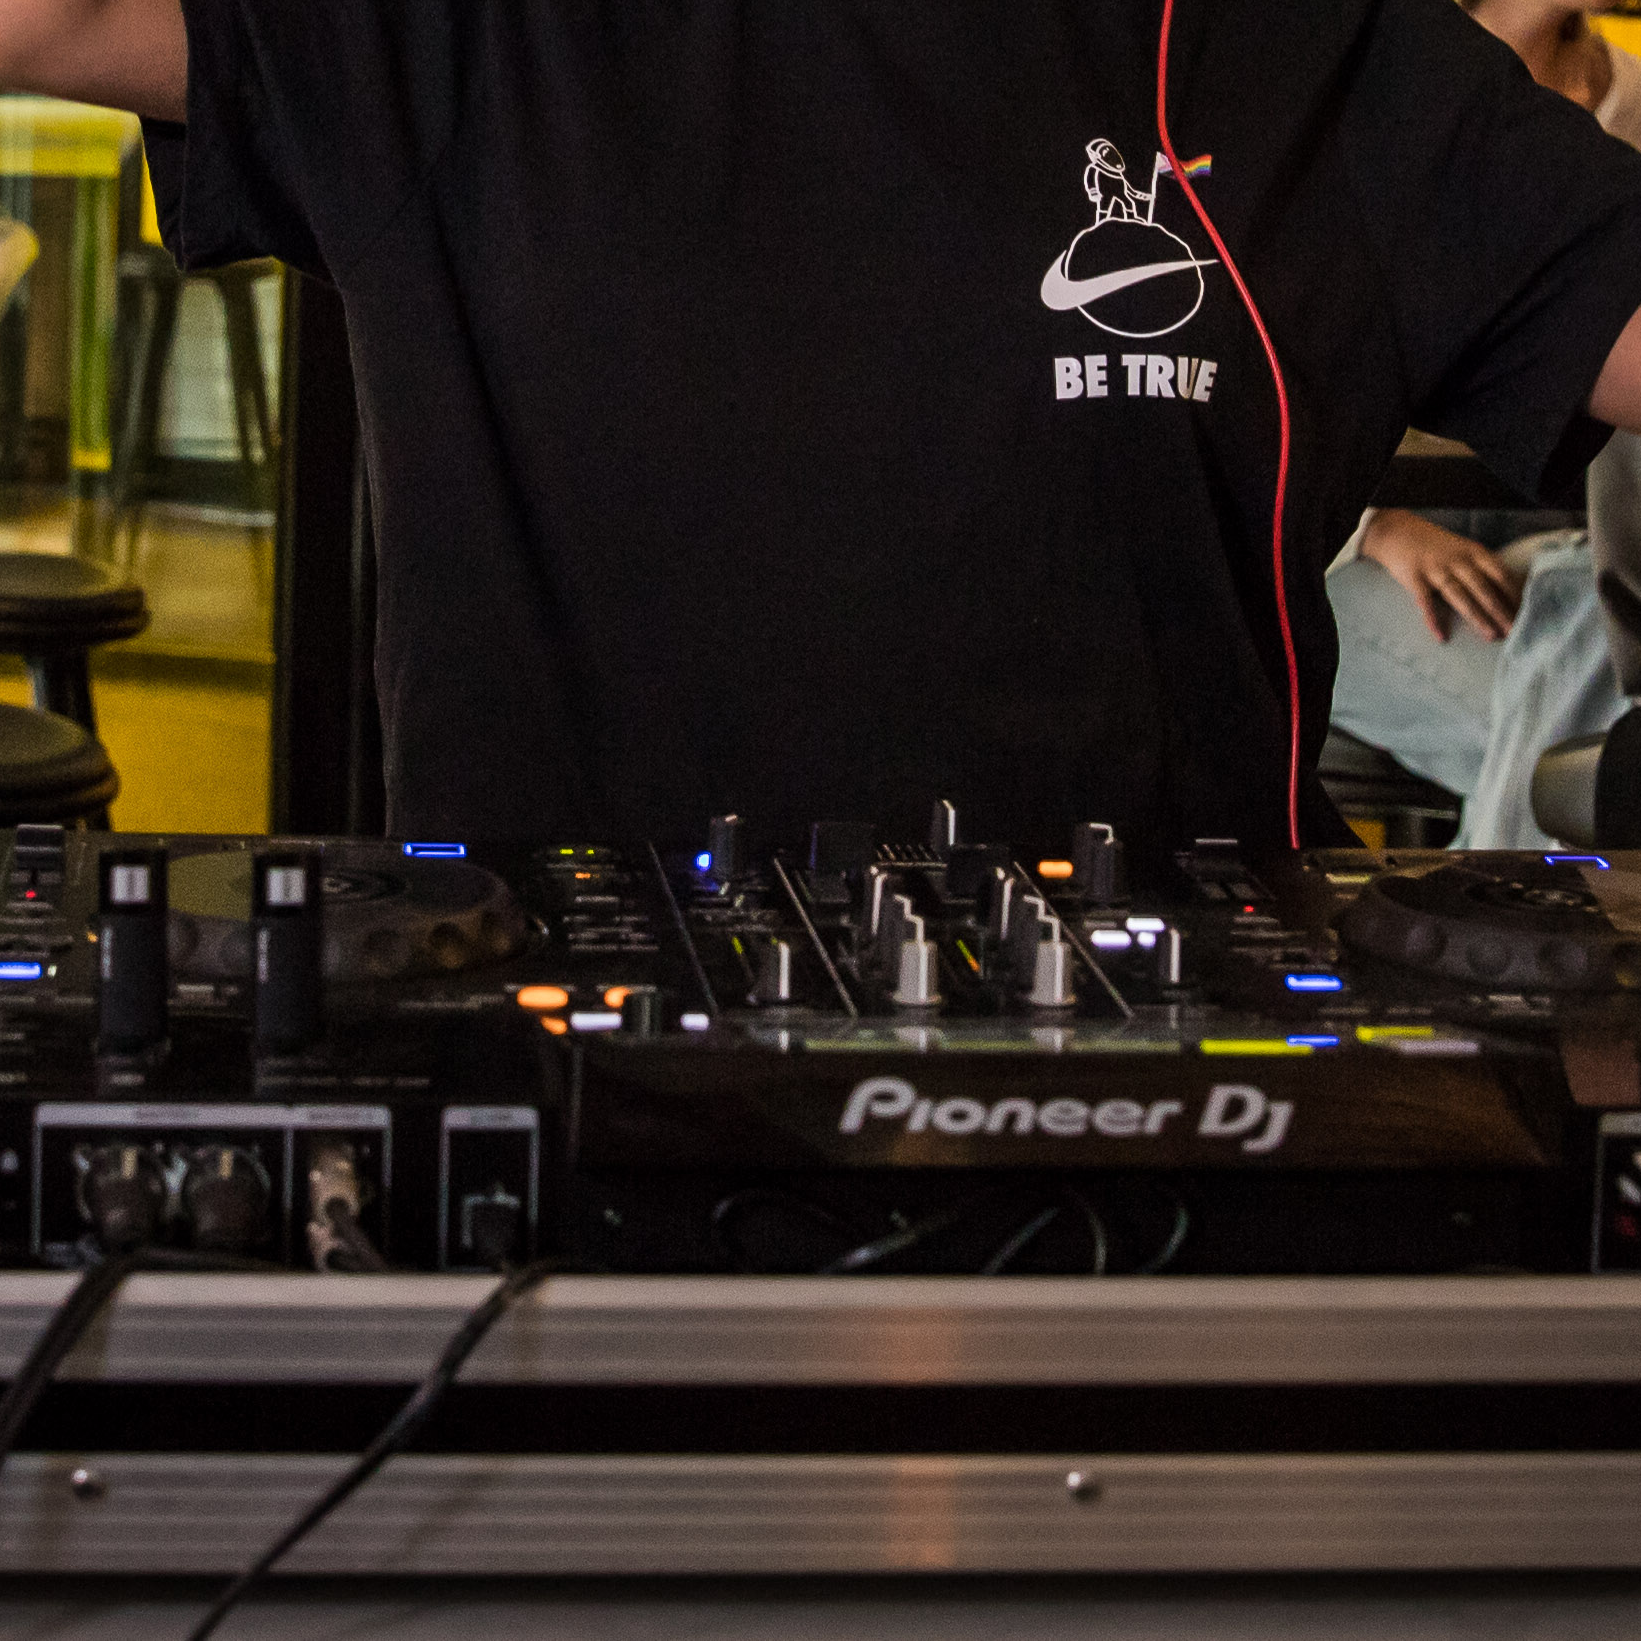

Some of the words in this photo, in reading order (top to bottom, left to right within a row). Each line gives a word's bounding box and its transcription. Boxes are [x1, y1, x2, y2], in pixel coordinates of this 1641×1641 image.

[1055, 354, 1108, 400] BE
[1121, 354, 1218, 402] TRUE
[839, 1076, 1184, 1136] Pioneer
